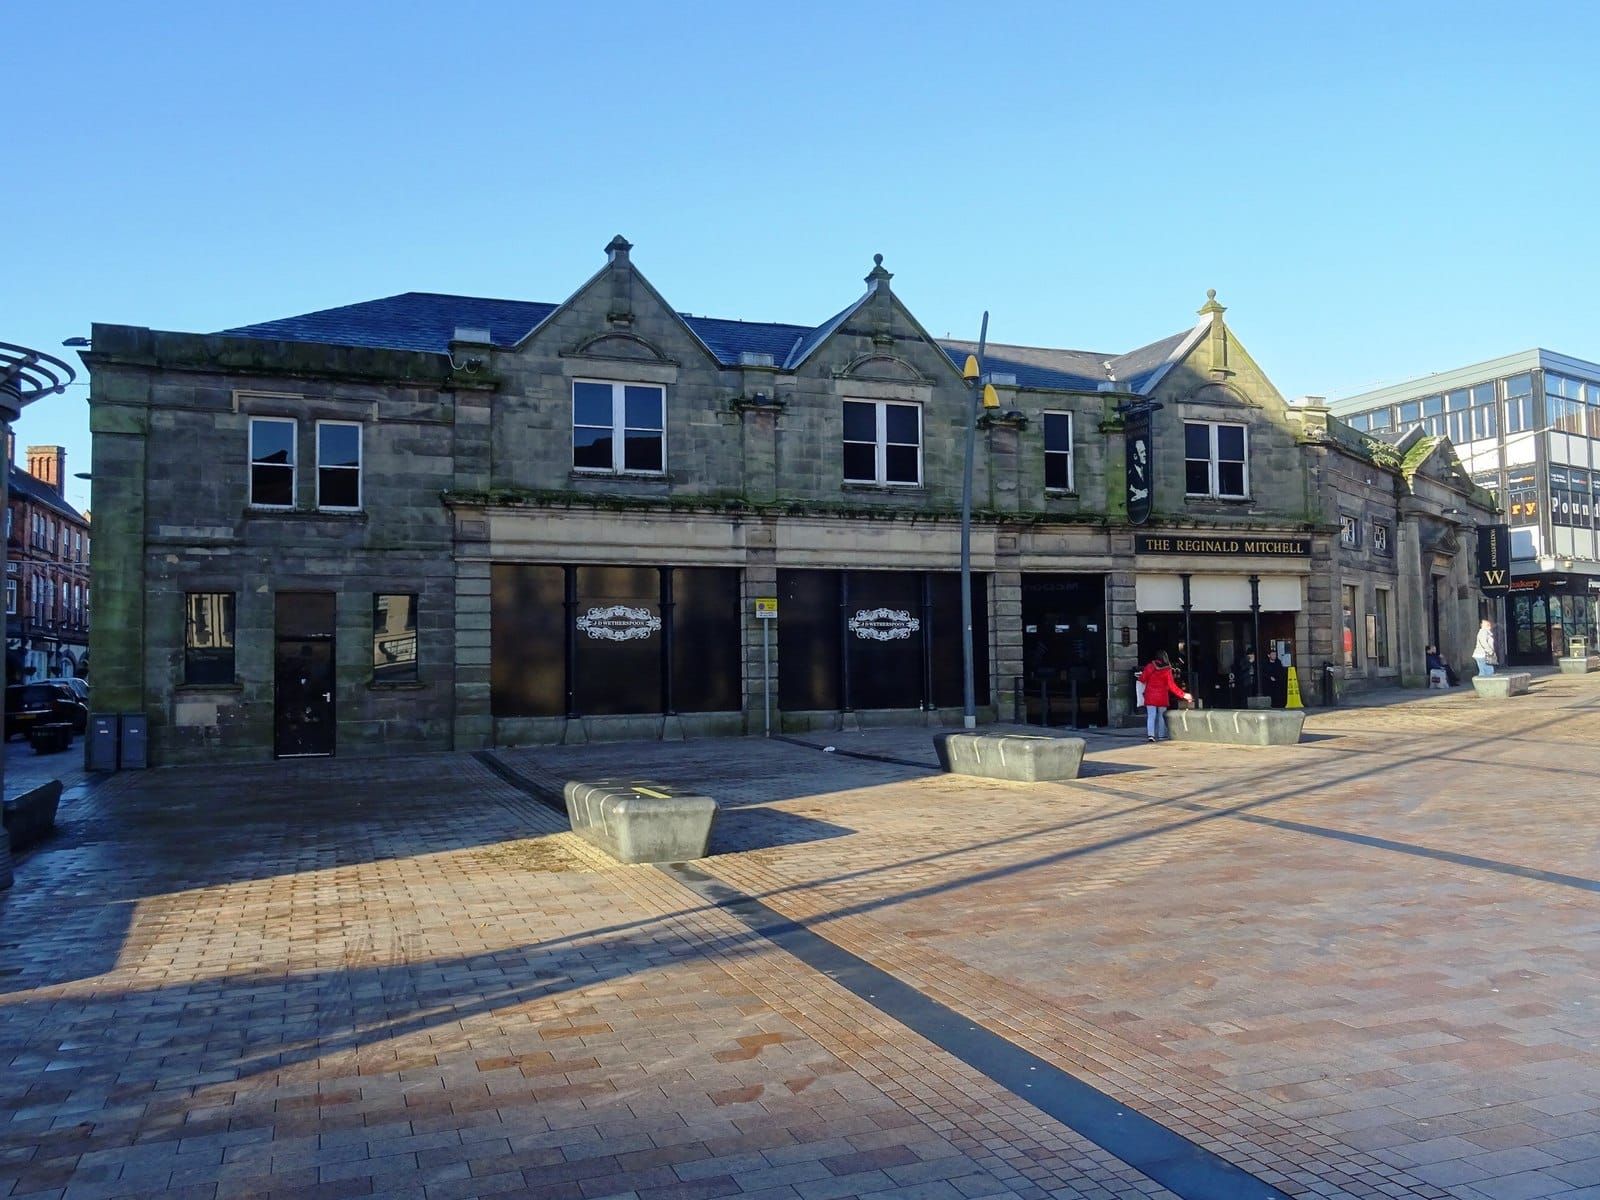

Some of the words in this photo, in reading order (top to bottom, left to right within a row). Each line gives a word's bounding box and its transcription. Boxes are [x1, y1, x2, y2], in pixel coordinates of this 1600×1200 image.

[1145, 539, 1170, 551] THE
[1176, 540, 1239, 552] REGINALD
[1244, 541, 1304, 554] MITCHELL
[1484, 569, 1506, 585] W
